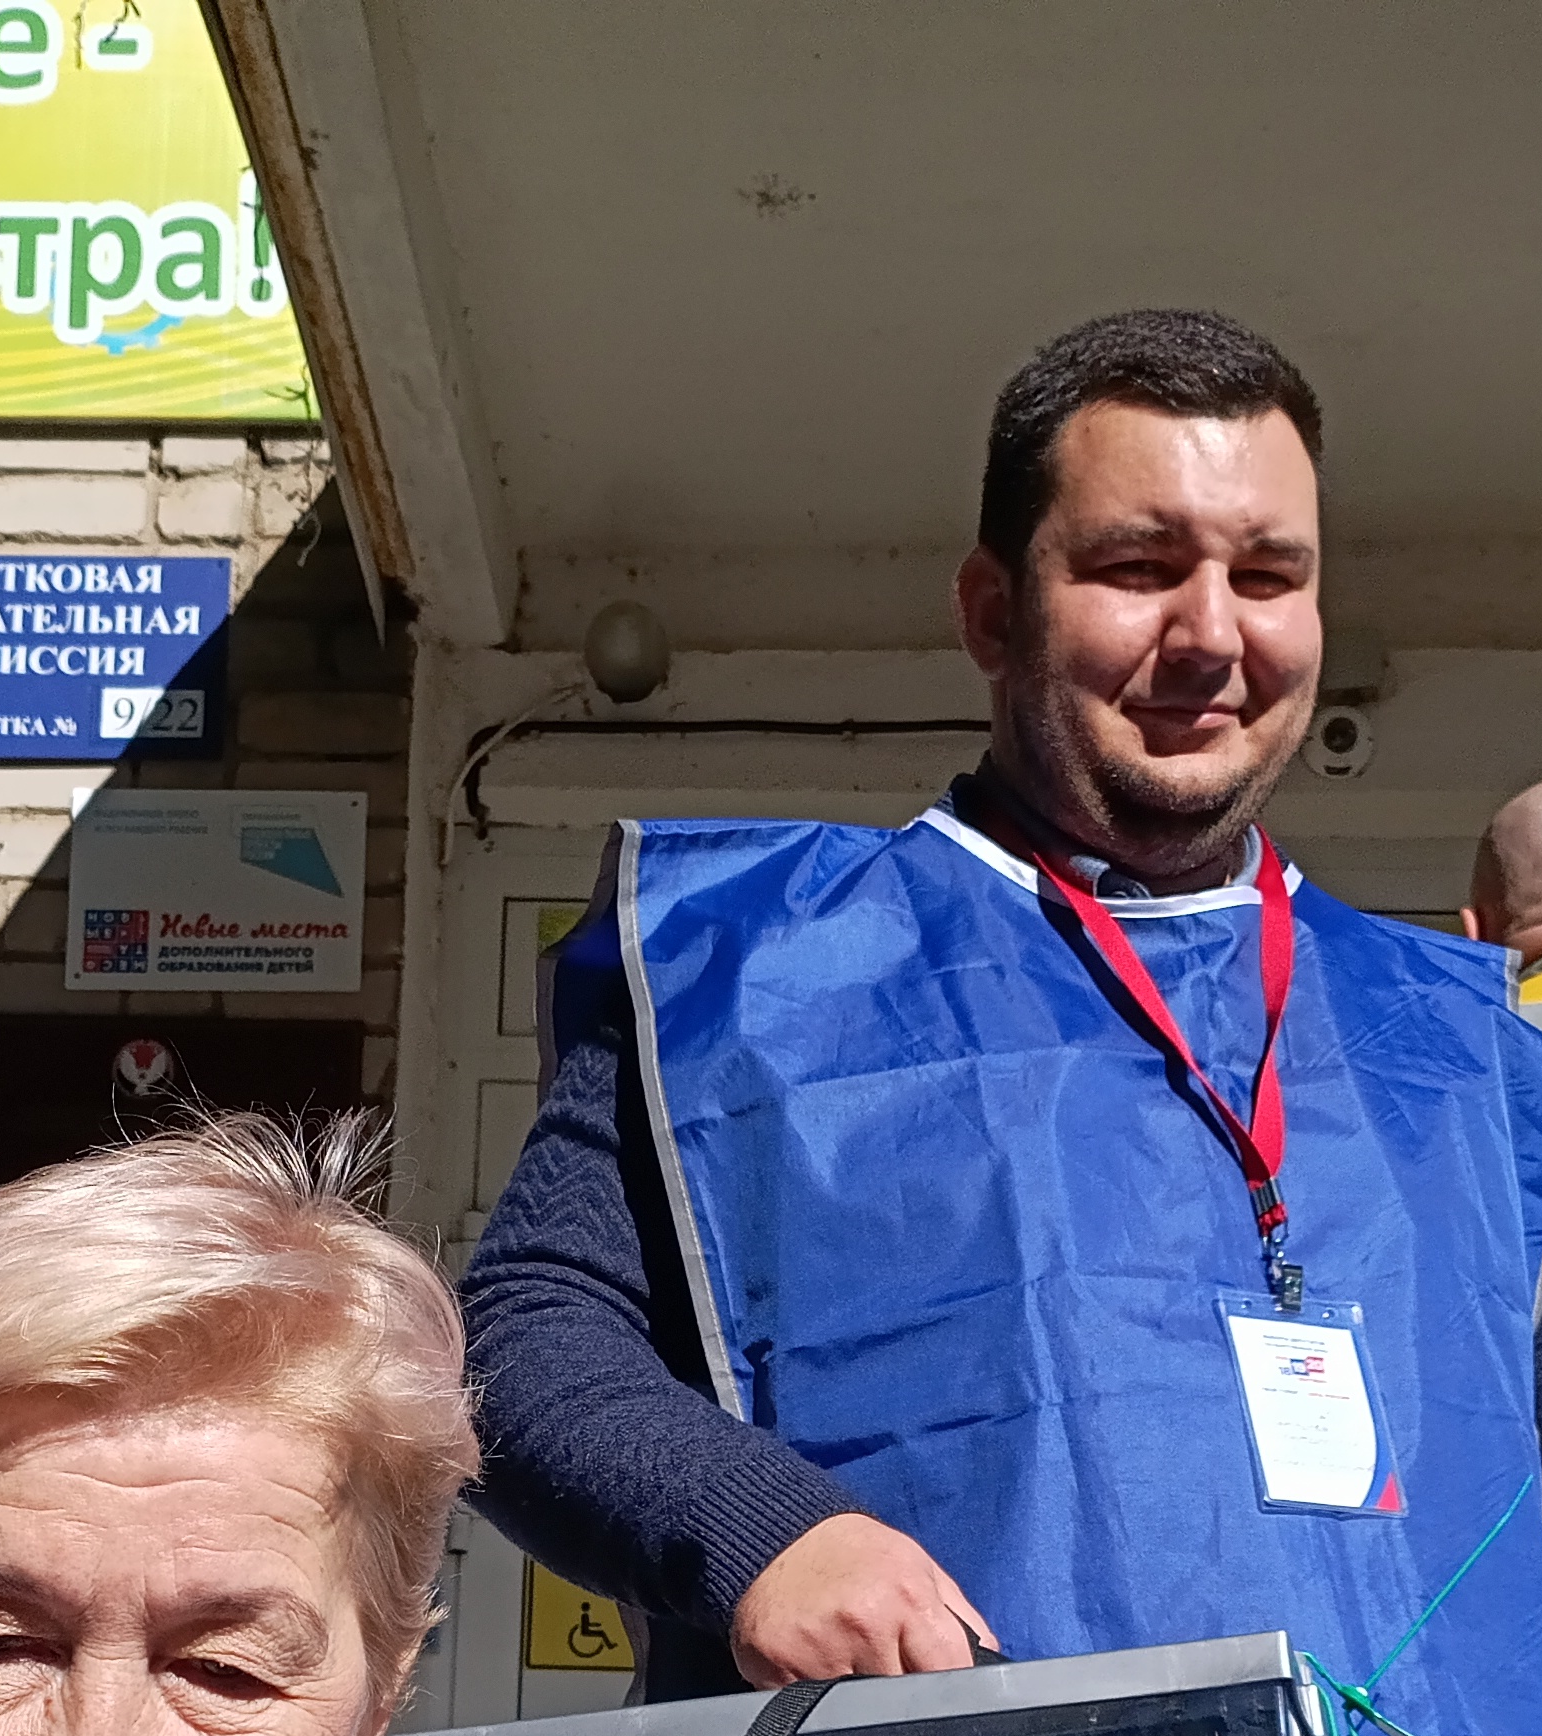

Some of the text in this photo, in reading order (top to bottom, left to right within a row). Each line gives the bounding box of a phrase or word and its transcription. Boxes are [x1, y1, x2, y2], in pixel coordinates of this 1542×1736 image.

[50, 716, 78, 737] №
[113, 696, 200, 732] 9/22
[160, 912, 349, 940] Новые места
[157, 945, 314, 961] ДОПОЛНИТЕЛЬНОГО
[156, 959, 314, 975] ОБРАЗОВАНИЯ ДЕТЕЙ
